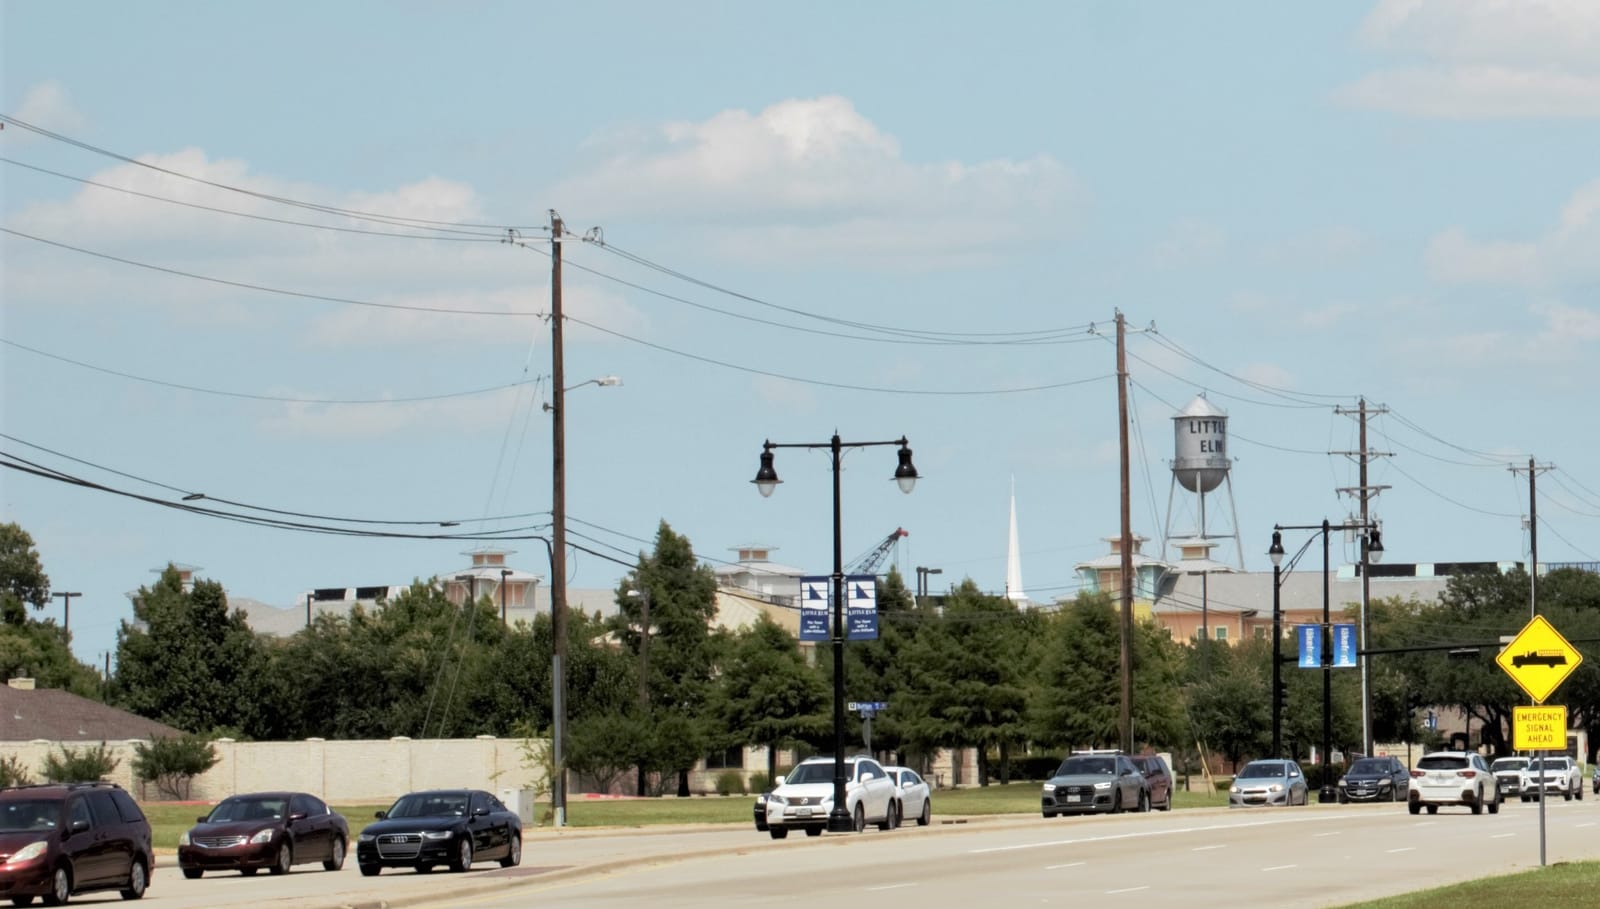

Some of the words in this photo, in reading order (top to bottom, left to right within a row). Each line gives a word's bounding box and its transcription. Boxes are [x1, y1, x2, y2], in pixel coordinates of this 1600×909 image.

[1516, 712, 1562, 721] EMERGENCY
[1526, 723, 1554, 732] SIGNAL
[1527, 734, 1553, 743] AHEAD
